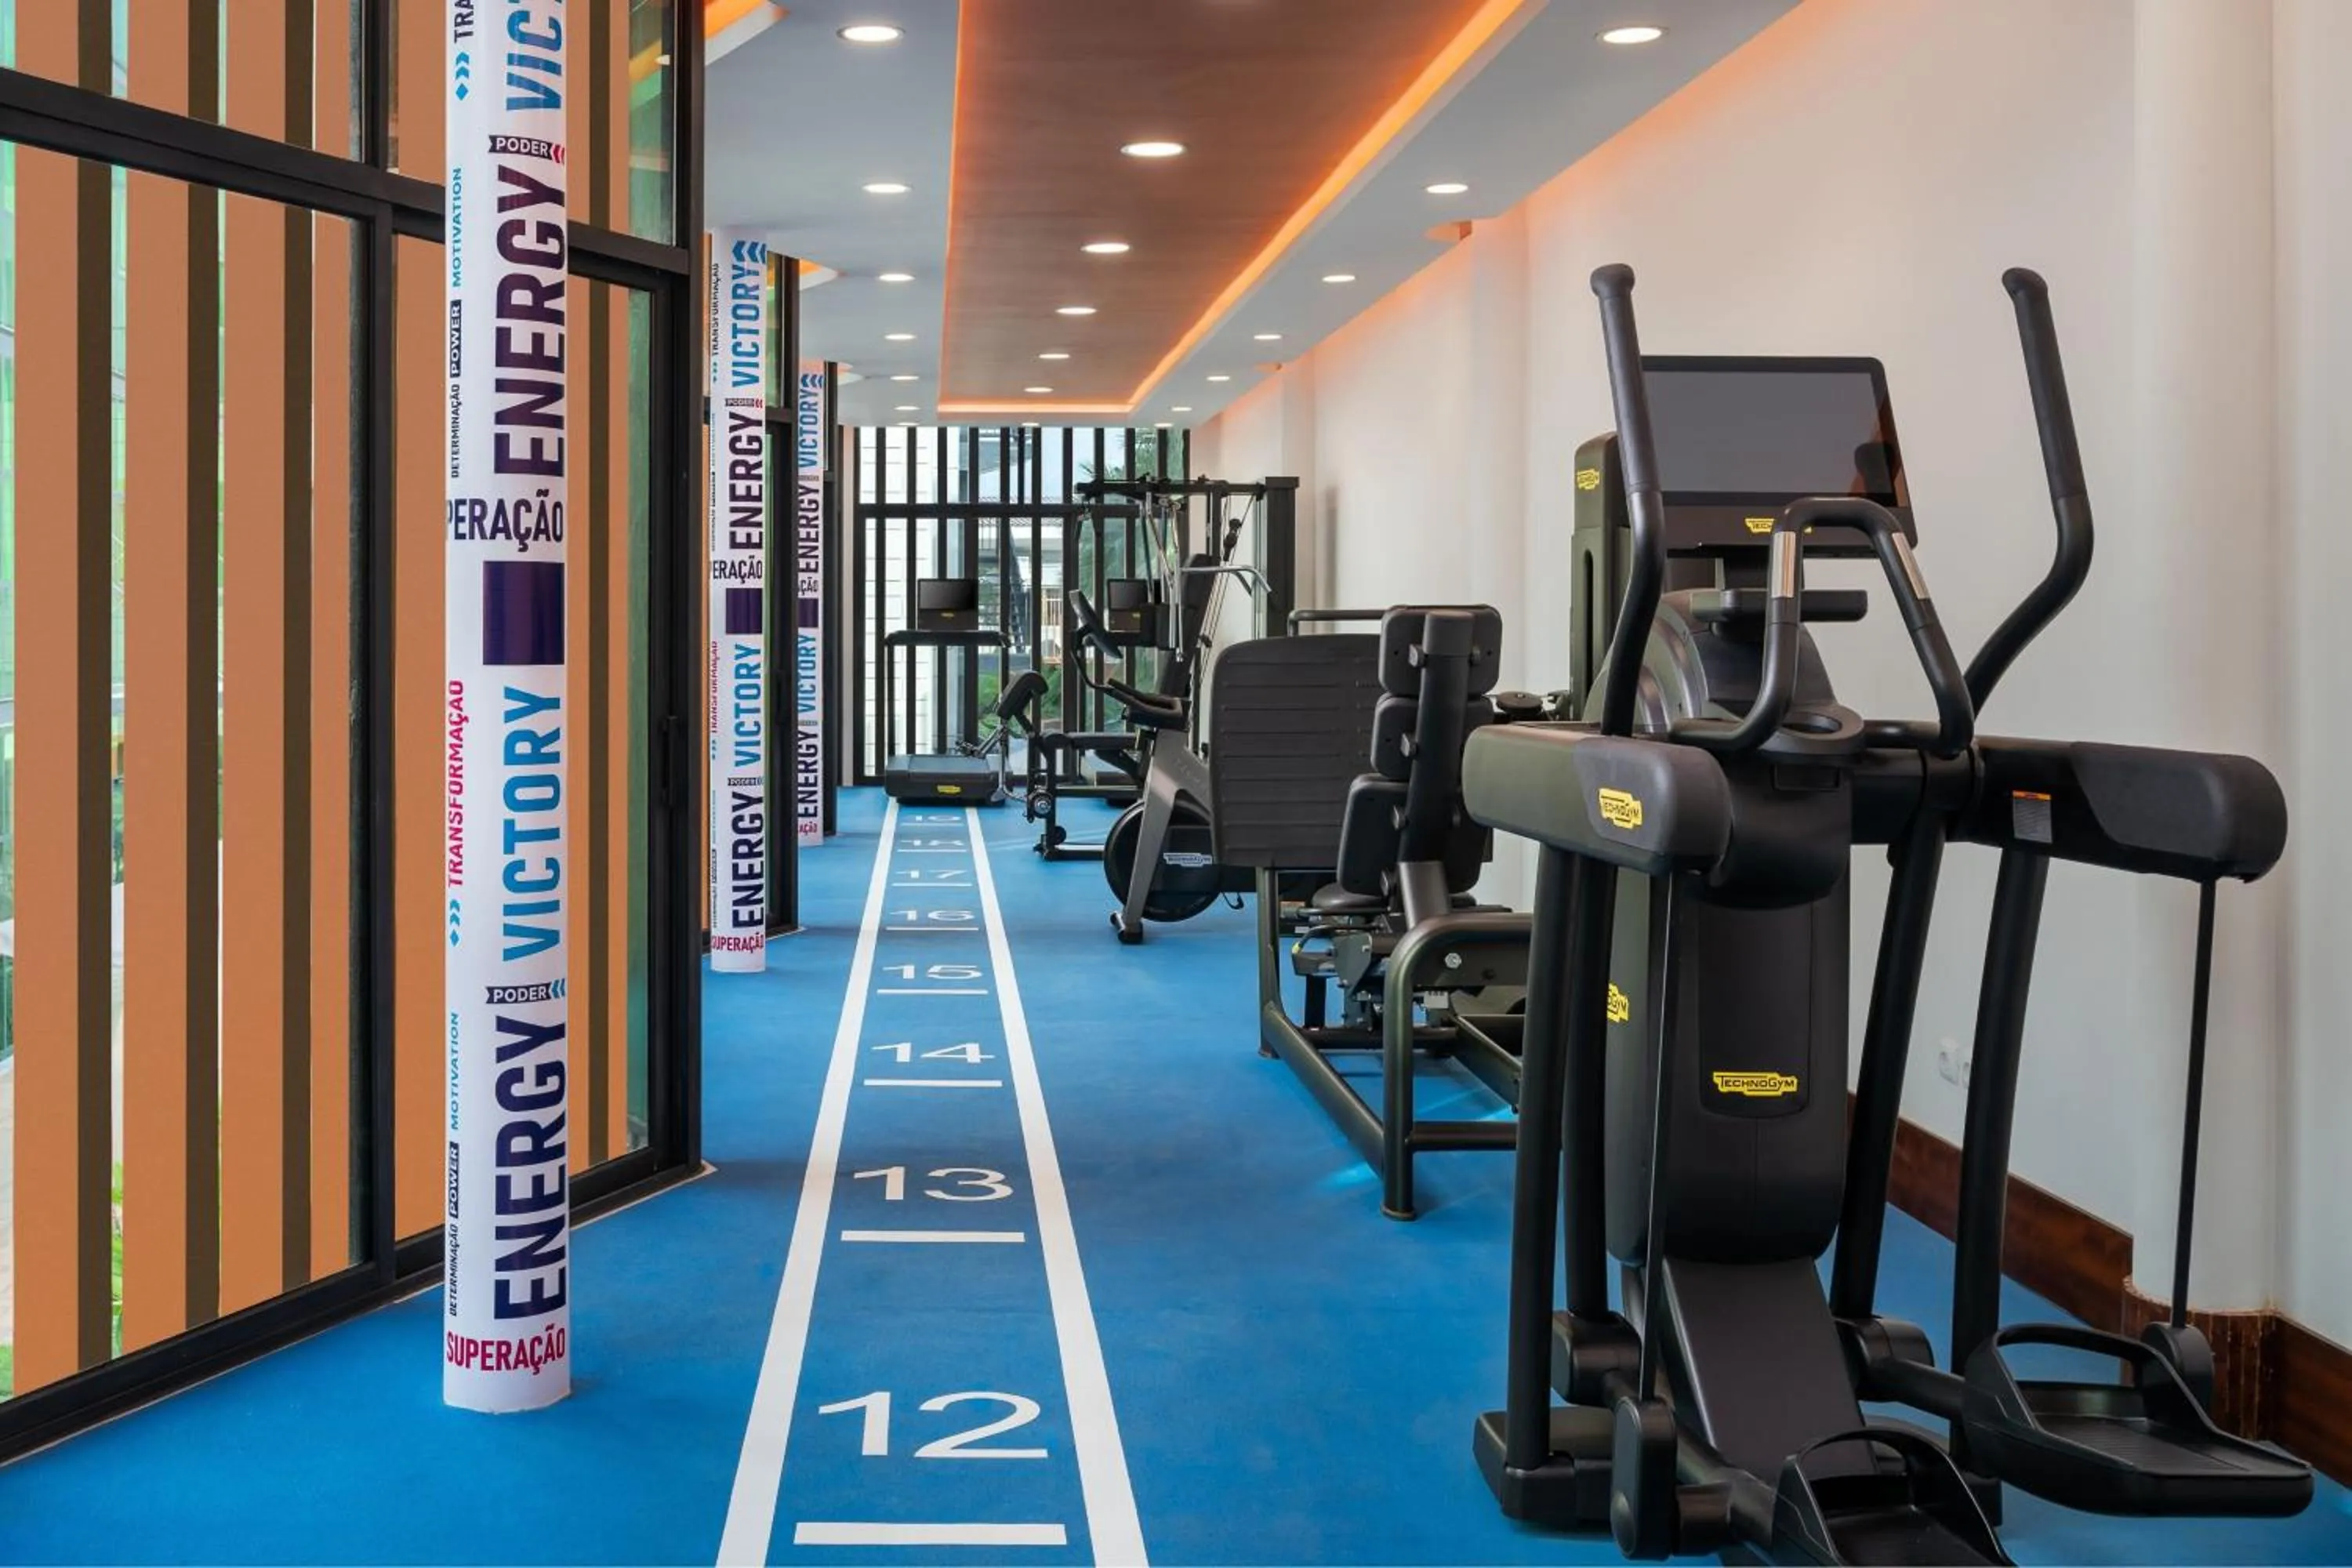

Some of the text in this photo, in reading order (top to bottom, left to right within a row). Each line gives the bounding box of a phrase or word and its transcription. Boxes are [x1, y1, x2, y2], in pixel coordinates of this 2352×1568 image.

[506, 0, 563, 111] VIC
[495, 136, 549, 157] PODER
[452, 168, 462, 287] MOTIVATION
[451, 303, 461, 376] POWER
[495, 164, 565, 477] ENERGY
[731, 264, 760, 387] VICTORY
[799, 389, 818, 468] VICTORY
[729, 411, 763, 550] ENERGY
[799, 485, 819, 574] ENERGY
[735, 644, 761, 768] VICTORY
[798, 634, 817, 713] VICTORY
[798, 729, 818, 818] ENERGY
[503, 685, 561, 962] VICTORY
[731, 791, 764, 929] ENERGY
[890, 909, 975, 921] 16
[493, 986, 547, 1004] PODER
[882, 964, 983, 980] 15
[451, 1013, 459, 1131] MOTIVATION
[871, 1042, 996, 1064] 14
[450, 1143, 459, 1217] POWER
[494, 1015, 567, 1320] ENERGY
[854, 1166, 1014, 1202] 13
[445, 1323, 565, 1376] SUPERAÇÃO
[818, 1391, 1048, 1458] 12
